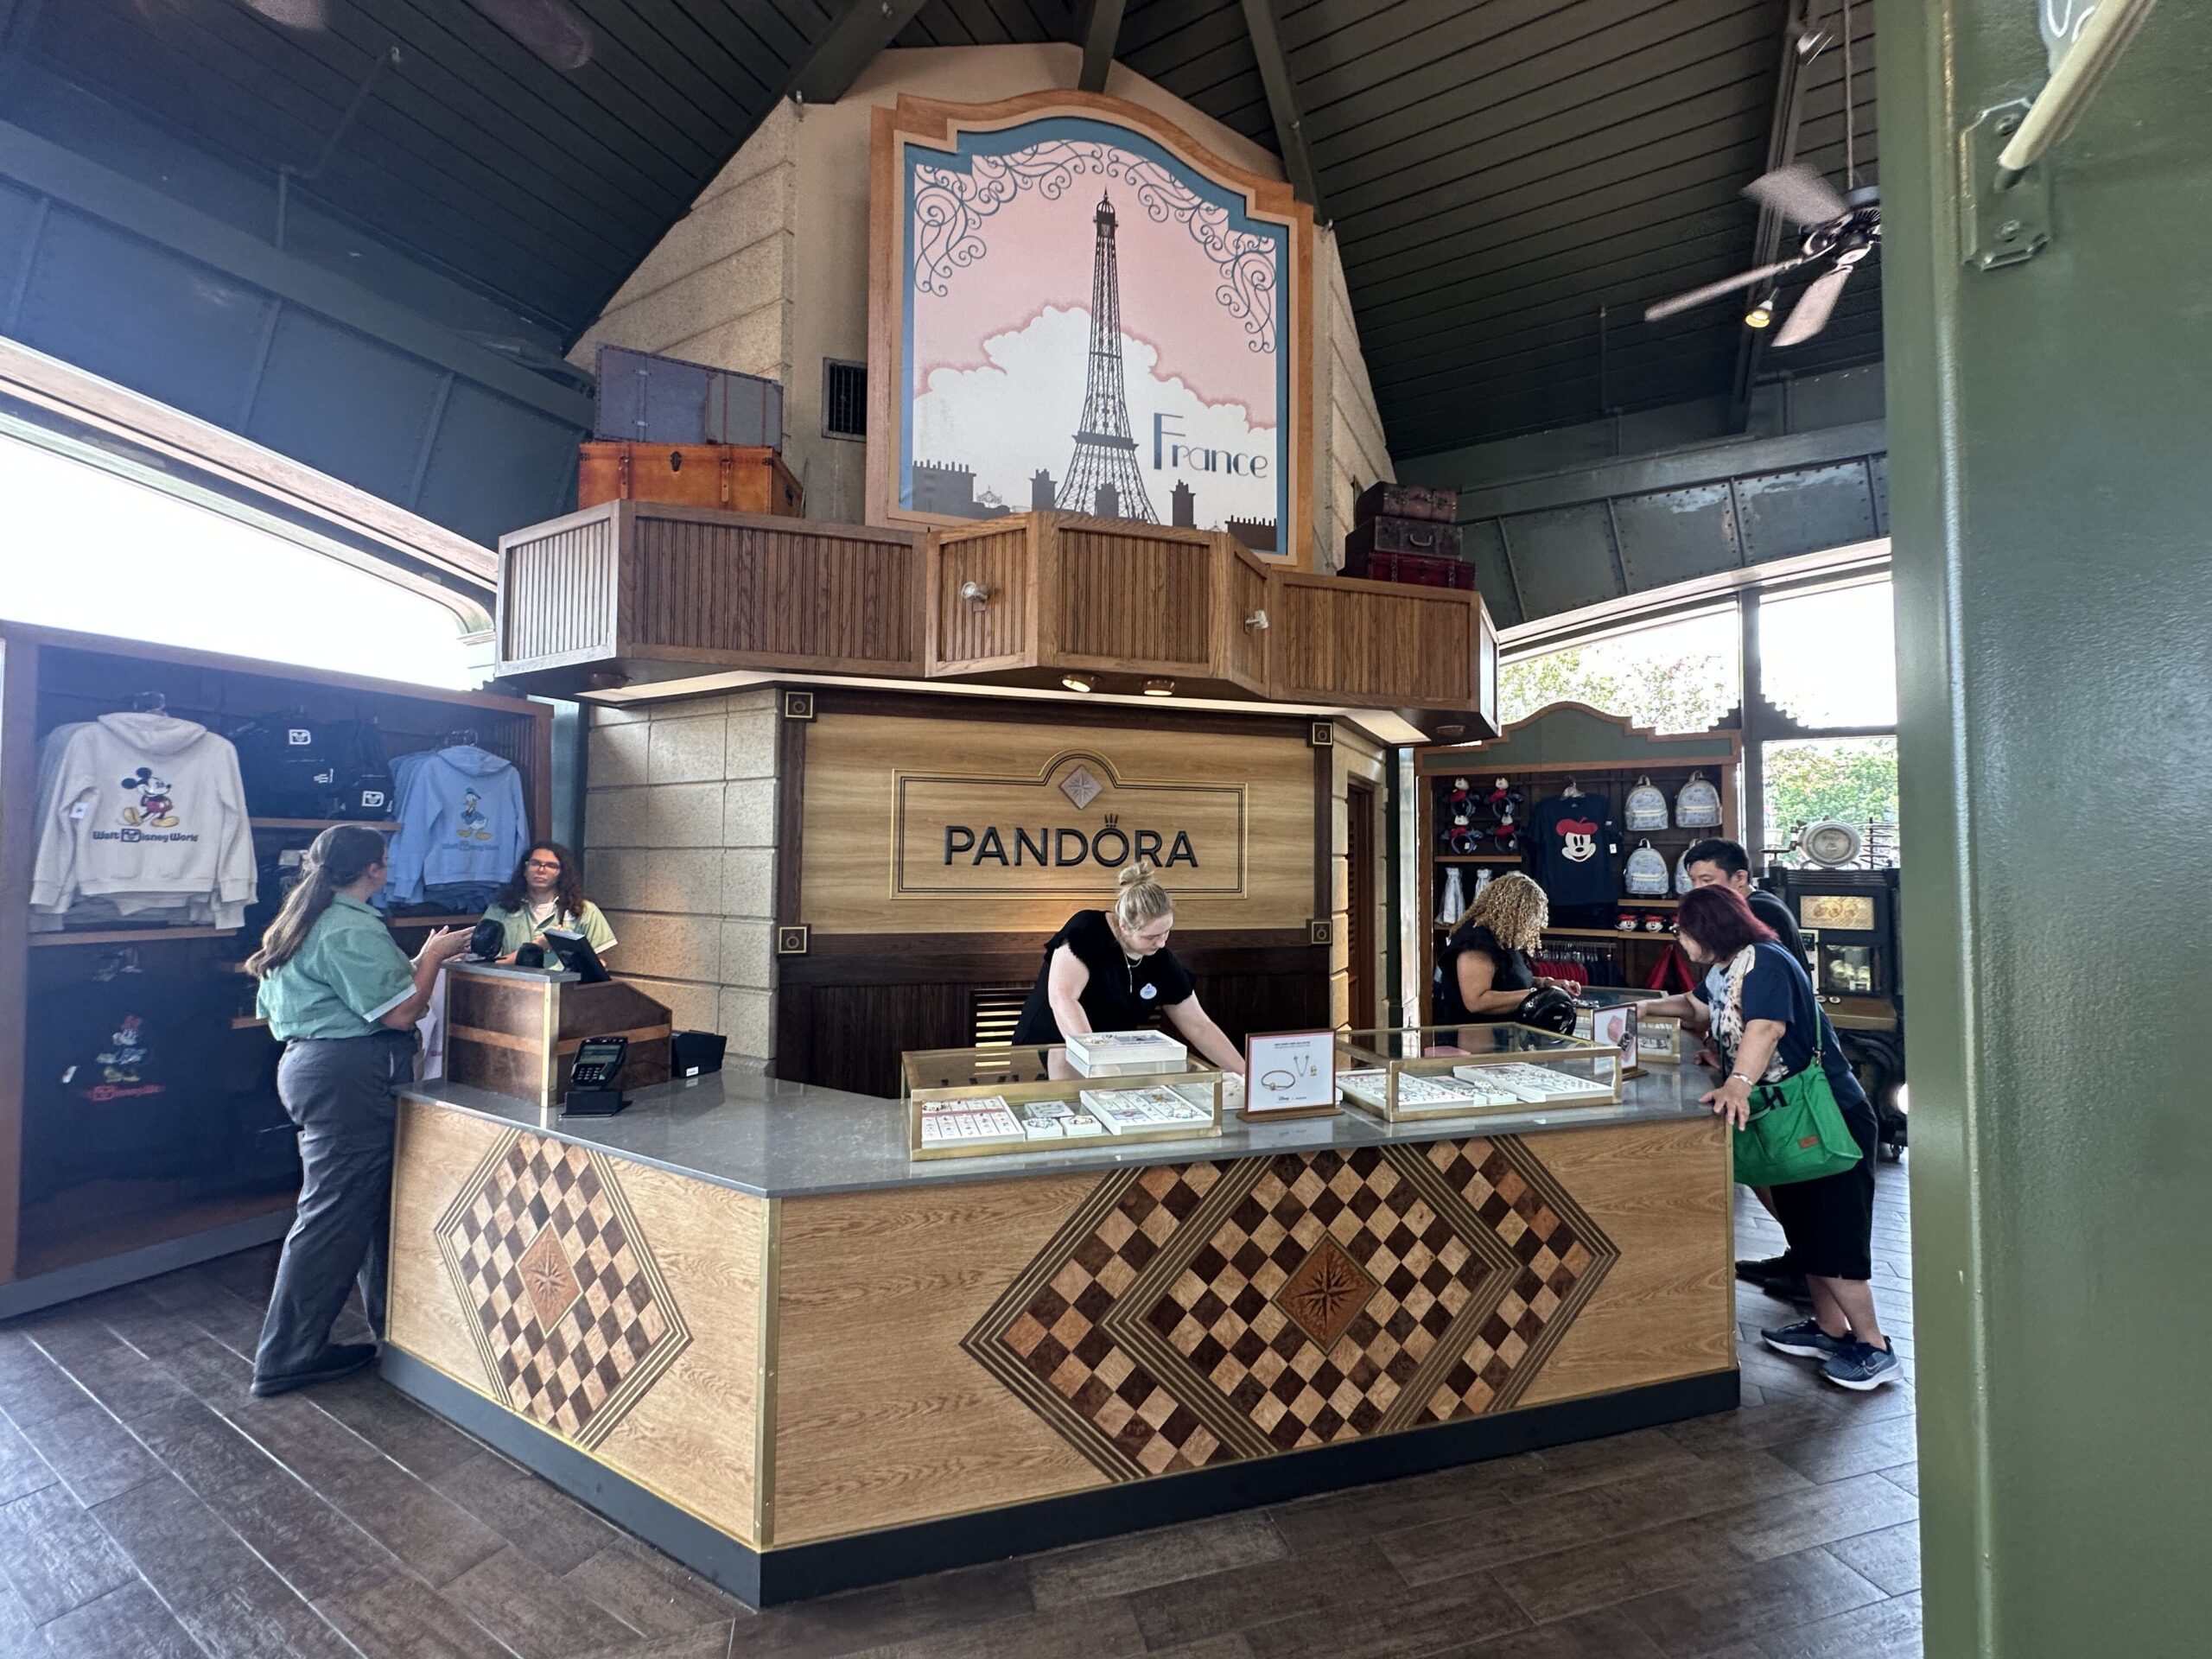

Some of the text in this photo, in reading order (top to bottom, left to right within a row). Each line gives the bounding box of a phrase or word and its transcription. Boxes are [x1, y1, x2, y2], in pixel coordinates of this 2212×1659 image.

[1154, 412, 1268, 479] France
[92, 831, 120, 840] Walt
[944, 824, 1199, 868] PANDORA
